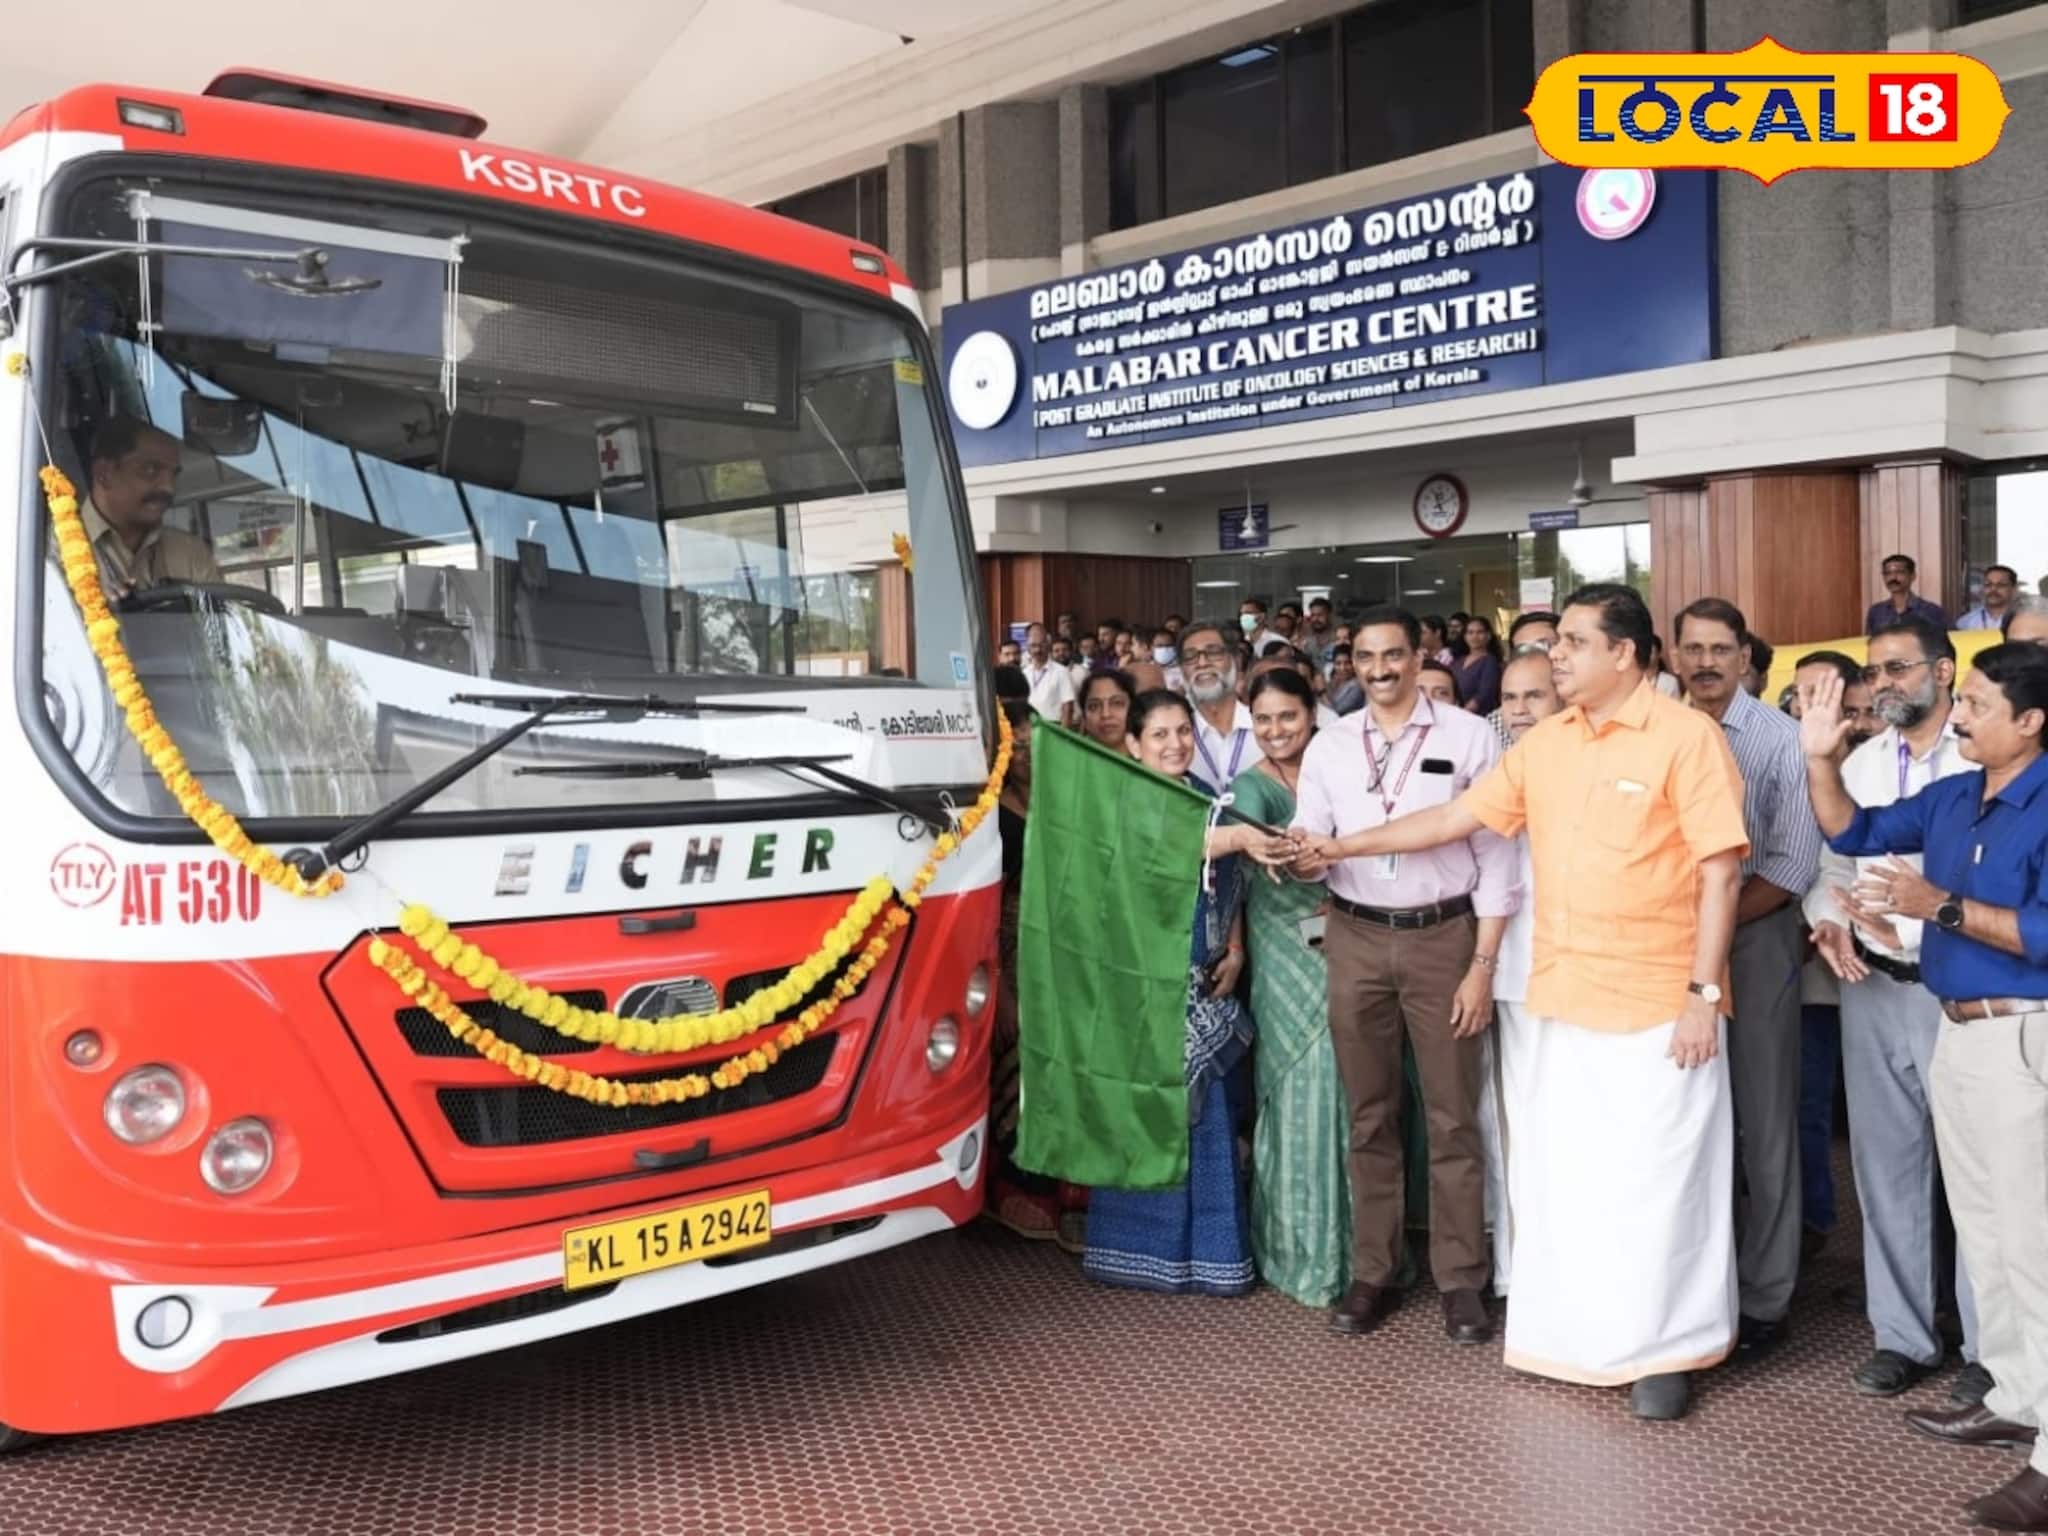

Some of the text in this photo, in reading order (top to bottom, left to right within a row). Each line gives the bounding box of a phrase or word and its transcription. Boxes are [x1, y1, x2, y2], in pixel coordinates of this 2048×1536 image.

[458, 149, 647, 218] KSRTC
[1031, 259, 1166, 320] മലബാർ
[1174, 215, 1352, 287] കാൻസർ
[1032, 283, 1538, 403] MALABAR CANCER CENTRE
[1075, 394, 1147, 423] GRADUATE
[1148, 384, 1220, 411] INSTITUTE
[1222, 380, 1243, 397] OF
[1245, 365, 1327, 395] ONCOLOGY
[1330, 350, 1409, 381] SCIENCES
[1412, 348, 1428, 367] &
[1086, 367, 1480, 438] An Autonomous Institution under Government of Kerala
[58, 862, 107, 890] TLY
[119, 859, 261, 926] AT 530
[494, 827, 835, 897] EICHER
[587, 1201, 767, 1273] KL 15 A 2942
